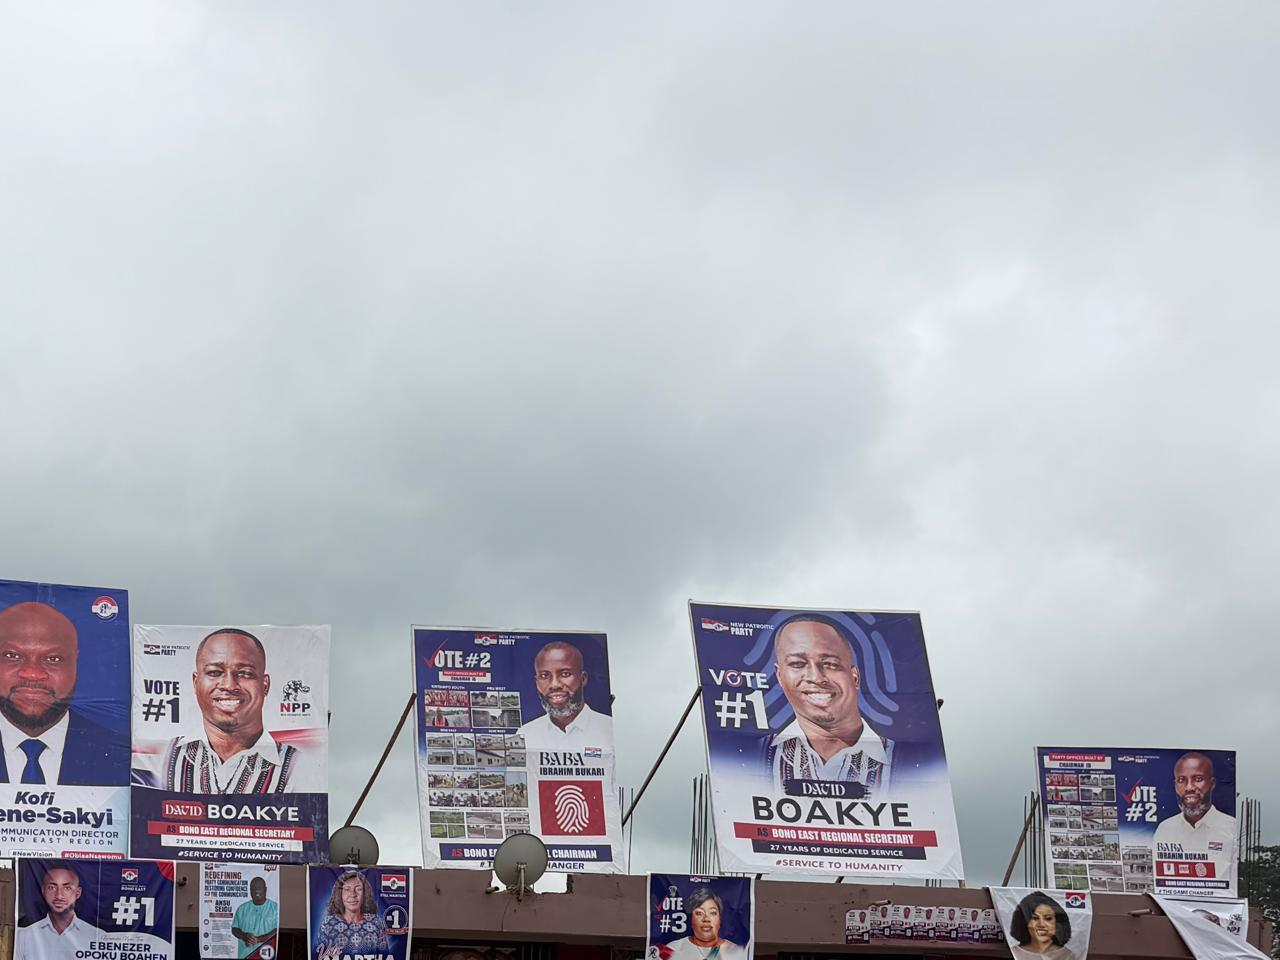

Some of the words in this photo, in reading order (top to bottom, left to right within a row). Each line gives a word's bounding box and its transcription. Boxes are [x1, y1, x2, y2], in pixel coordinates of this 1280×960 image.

[731, 628, 753, 637] PARTY
[465, 652, 491, 669] #2
[708, 669, 769, 689] VOTE
[144, 679, 180, 696] VOTE
[142, 697, 180, 723] #1
[281, 703, 311, 713] NPP
[715, 690, 769, 730] #1
[540, 751, 584, 766] BABA
[540, 767, 573, 777] IBRAHIM
[575, 768, 605, 777] BUKARI
[802, 782, 845, 796] DAVID
[15, 791, 55, 806] Kofi
[165, 804, 202, 815] DAVID
[207, 804, 299, 821] BOAKYE
[752, 796, 912, 826] BOAKYE
[1125, 803, 1158, 822] #2
[71, 830, 119, 839] DIRECTOR
[179, 826, 199, 835] BONO
[200, 826, 218, 836] EAST
[220, 827, 253, 837] REGIONAL
[255, 828, 295, 838] SECRETARY
[772, 829, 797, 840] BONO
[798, 830, 819, 841] EAST
[821, 831, 864, 843] REGIONAL
[865, 833, 914, 844] SECRETARY
[70, 838, 113, 846] REGION
[220, 840, 256, 848] DEDICATED
[178, 850, 219, 859] #SERVICE
[235, 852, 283, 861] HUMANITY
[464, 848, 487, 858] BONO
[552, 849, 597, 859] CHAIRMAN
[871, 849, 903, 857] SERVICE
[776, 859, 824, 868] #SERVICE
[829, 861, 842, 869] TO
[845, 862, 903, 872] HUMANITY
[204, 871, 242, 880] REDEFINING
[112, 896, 155, 927] #1
[660, 912, 687, 933] #3
[90, 942, 151, 953] EBENEZER
